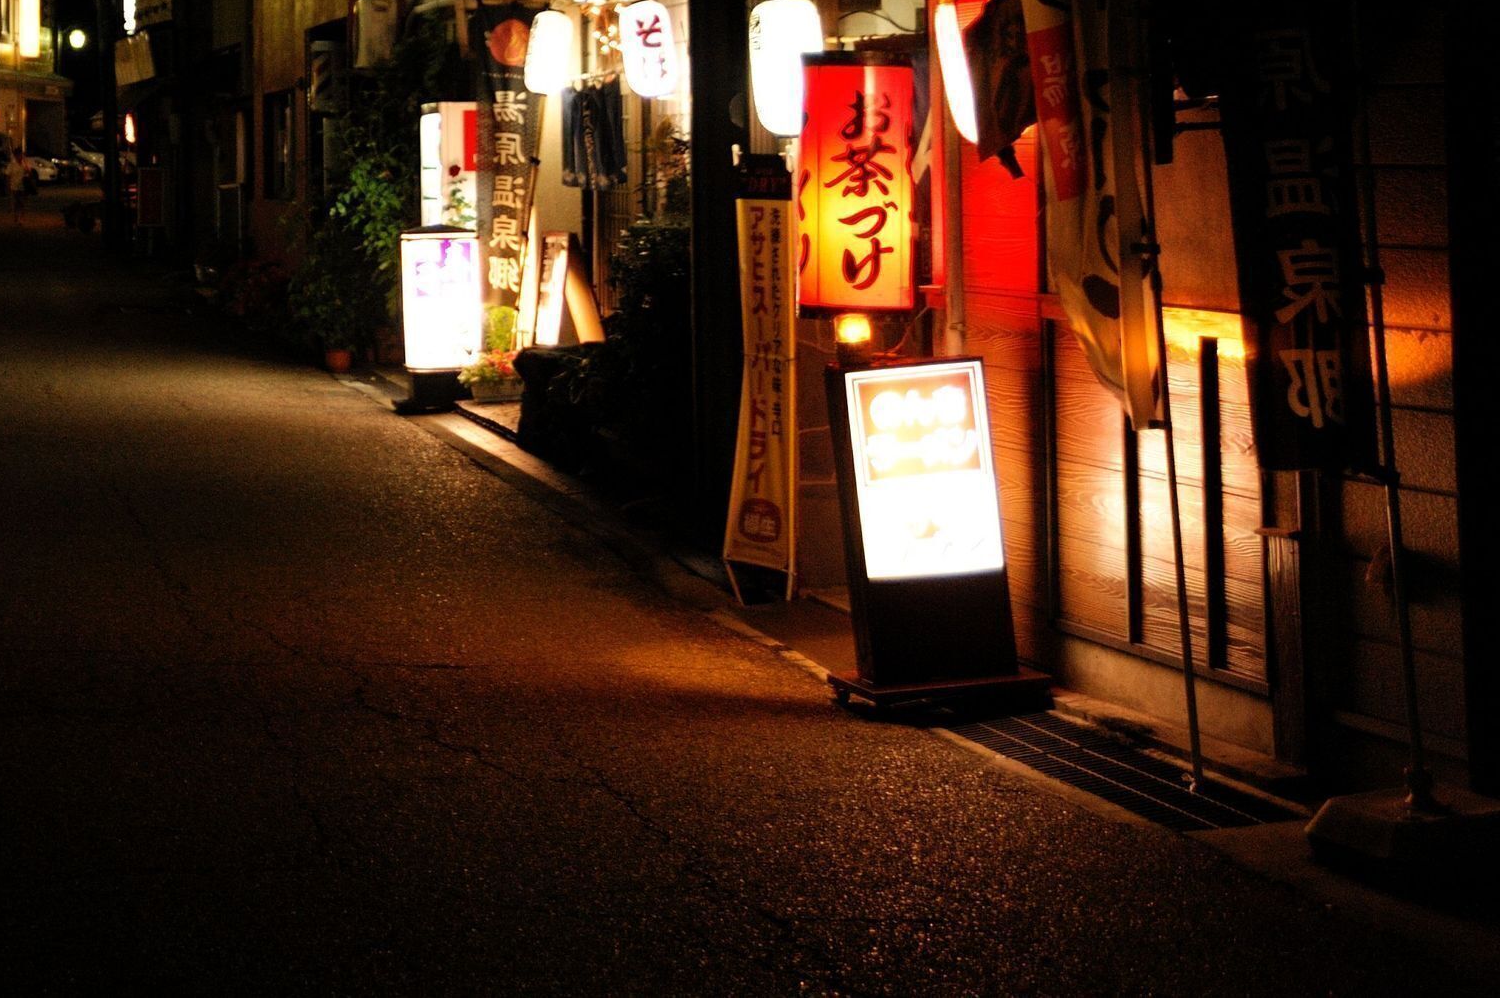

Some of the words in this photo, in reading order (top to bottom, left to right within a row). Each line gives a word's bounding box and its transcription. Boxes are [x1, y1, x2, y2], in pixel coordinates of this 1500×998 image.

[823, 90, 898, 290] お茶づけ
[748, 205, 771, 493] アサヒスーパードライ
